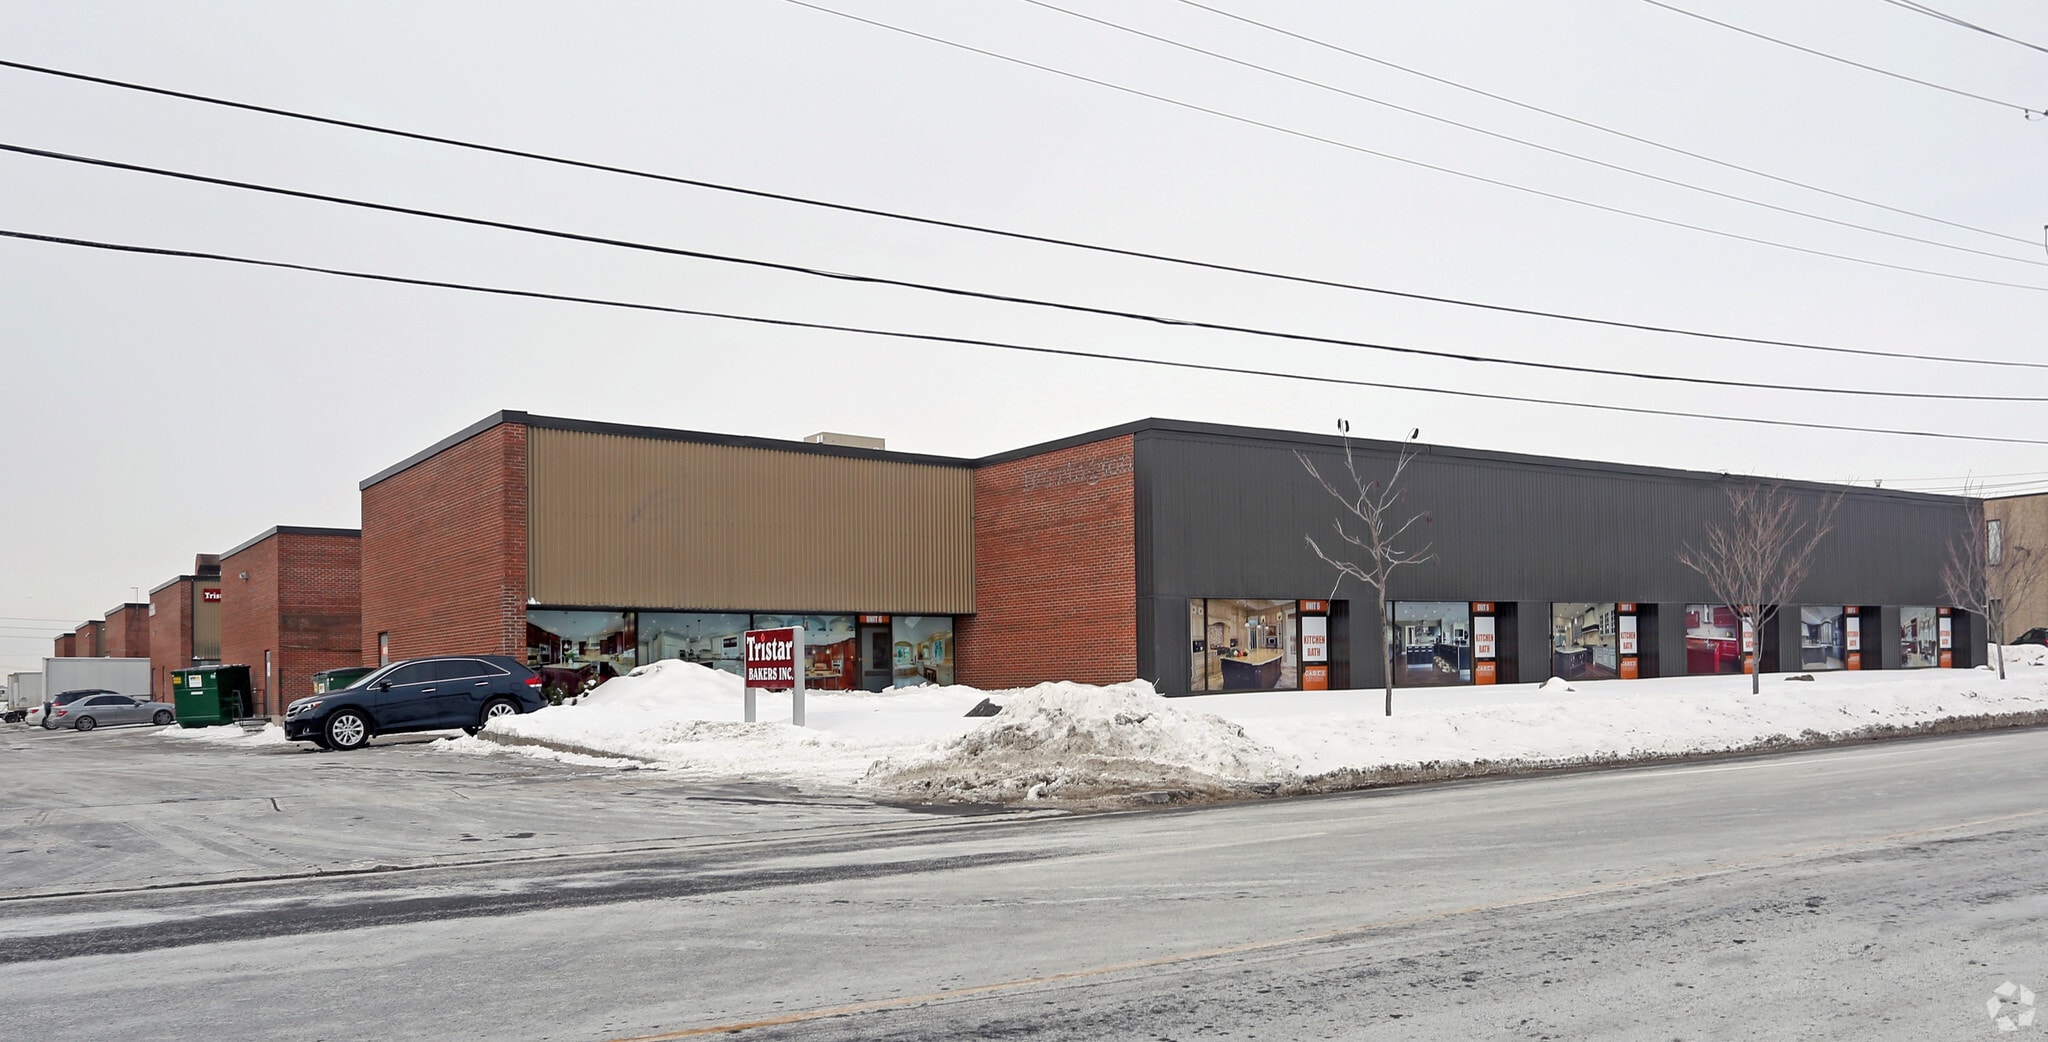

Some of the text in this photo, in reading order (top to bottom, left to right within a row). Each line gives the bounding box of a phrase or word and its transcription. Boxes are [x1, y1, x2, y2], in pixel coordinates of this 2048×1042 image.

[1304, 636, 1325, 645] KITCHEN
[746, 634, 793, 661] Tristar
[1307, 647, 1321, 657] BATH
[748, 666, 794, 681] BAKERS INC.
